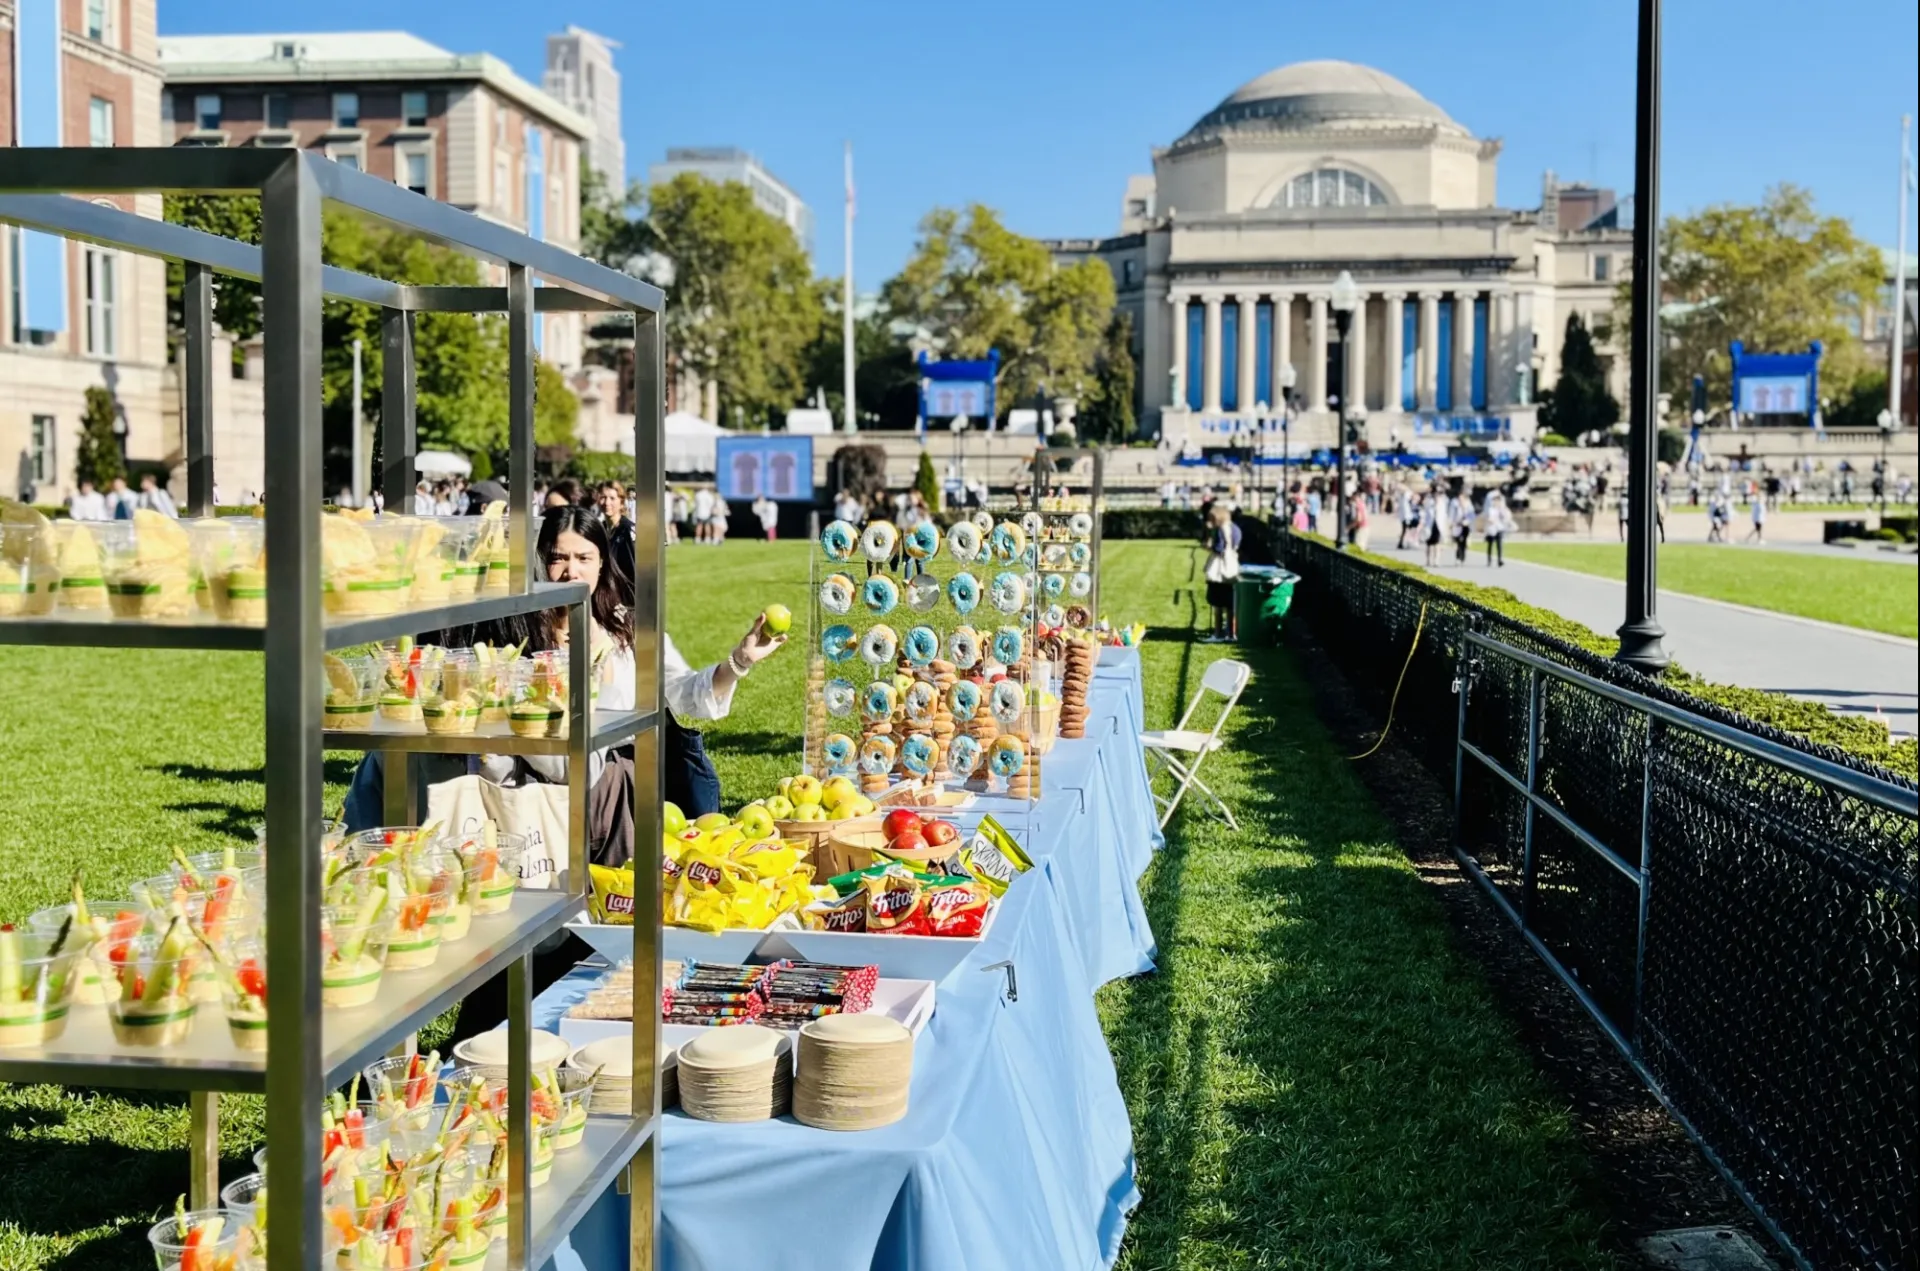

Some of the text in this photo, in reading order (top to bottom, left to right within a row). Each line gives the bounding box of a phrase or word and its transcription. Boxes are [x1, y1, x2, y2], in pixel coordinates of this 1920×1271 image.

[663, 855, 683, 878] Lay
[973, 840, 1010, 880] SKINNY
[607, 894, 634, 914] Lay
[873, 888, 916, 917] Fritos
[932, 888, 975, 907] Fritos
[825, 906, 864, 931] Fritos
